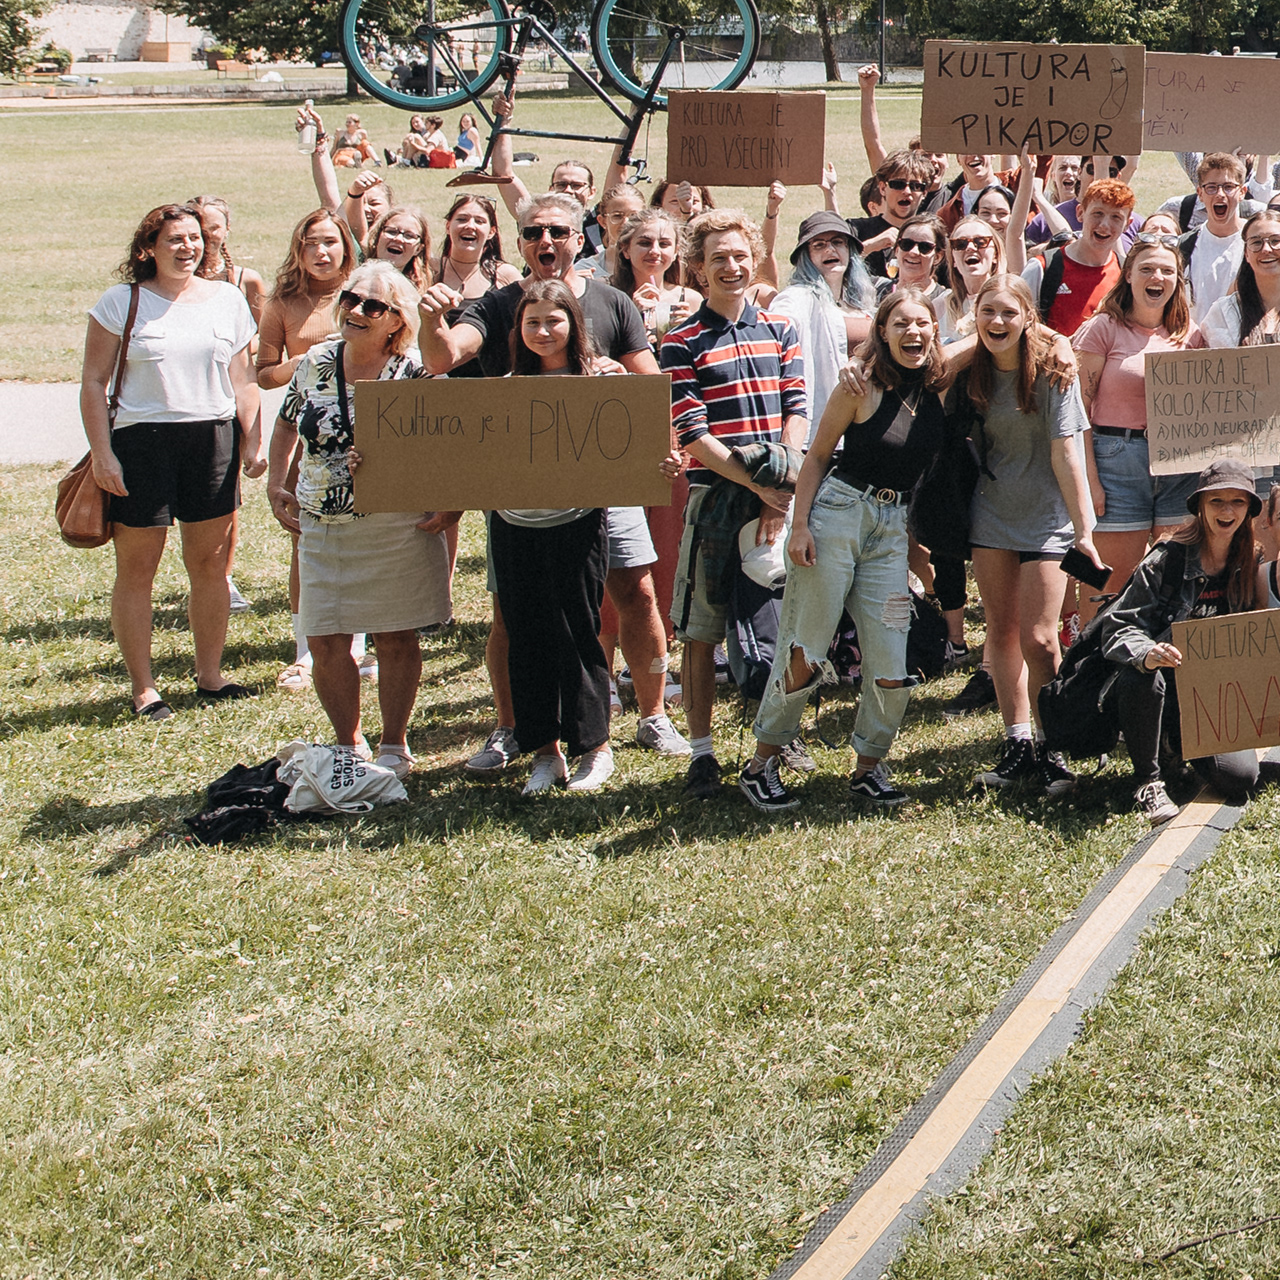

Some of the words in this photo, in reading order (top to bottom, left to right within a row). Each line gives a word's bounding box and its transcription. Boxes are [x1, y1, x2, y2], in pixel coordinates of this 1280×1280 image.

[938, 48, 1091, 81] KULTURA
[1145, 67, 1207, 93] TURA
[1223, 80, 1246, 94] JE
[993, 86, 1025, 107] JE
[683, 102, 745, 126] KULTURA
[766, 103, 785, 127] JE
[951, 113, 1113, 154] PIKADOR
[680, 135, 708, 167] PRO
[722, 133, 794, 170] VŠECHNY
[1151, 356, 1225, 386] KULTURA
[377, 395, 465, 439] Kultura
[478, 414, 496, 443] je
[530, 398, 632, 464] PIVO
[1185, 617, 1280, 661] KULTURA
